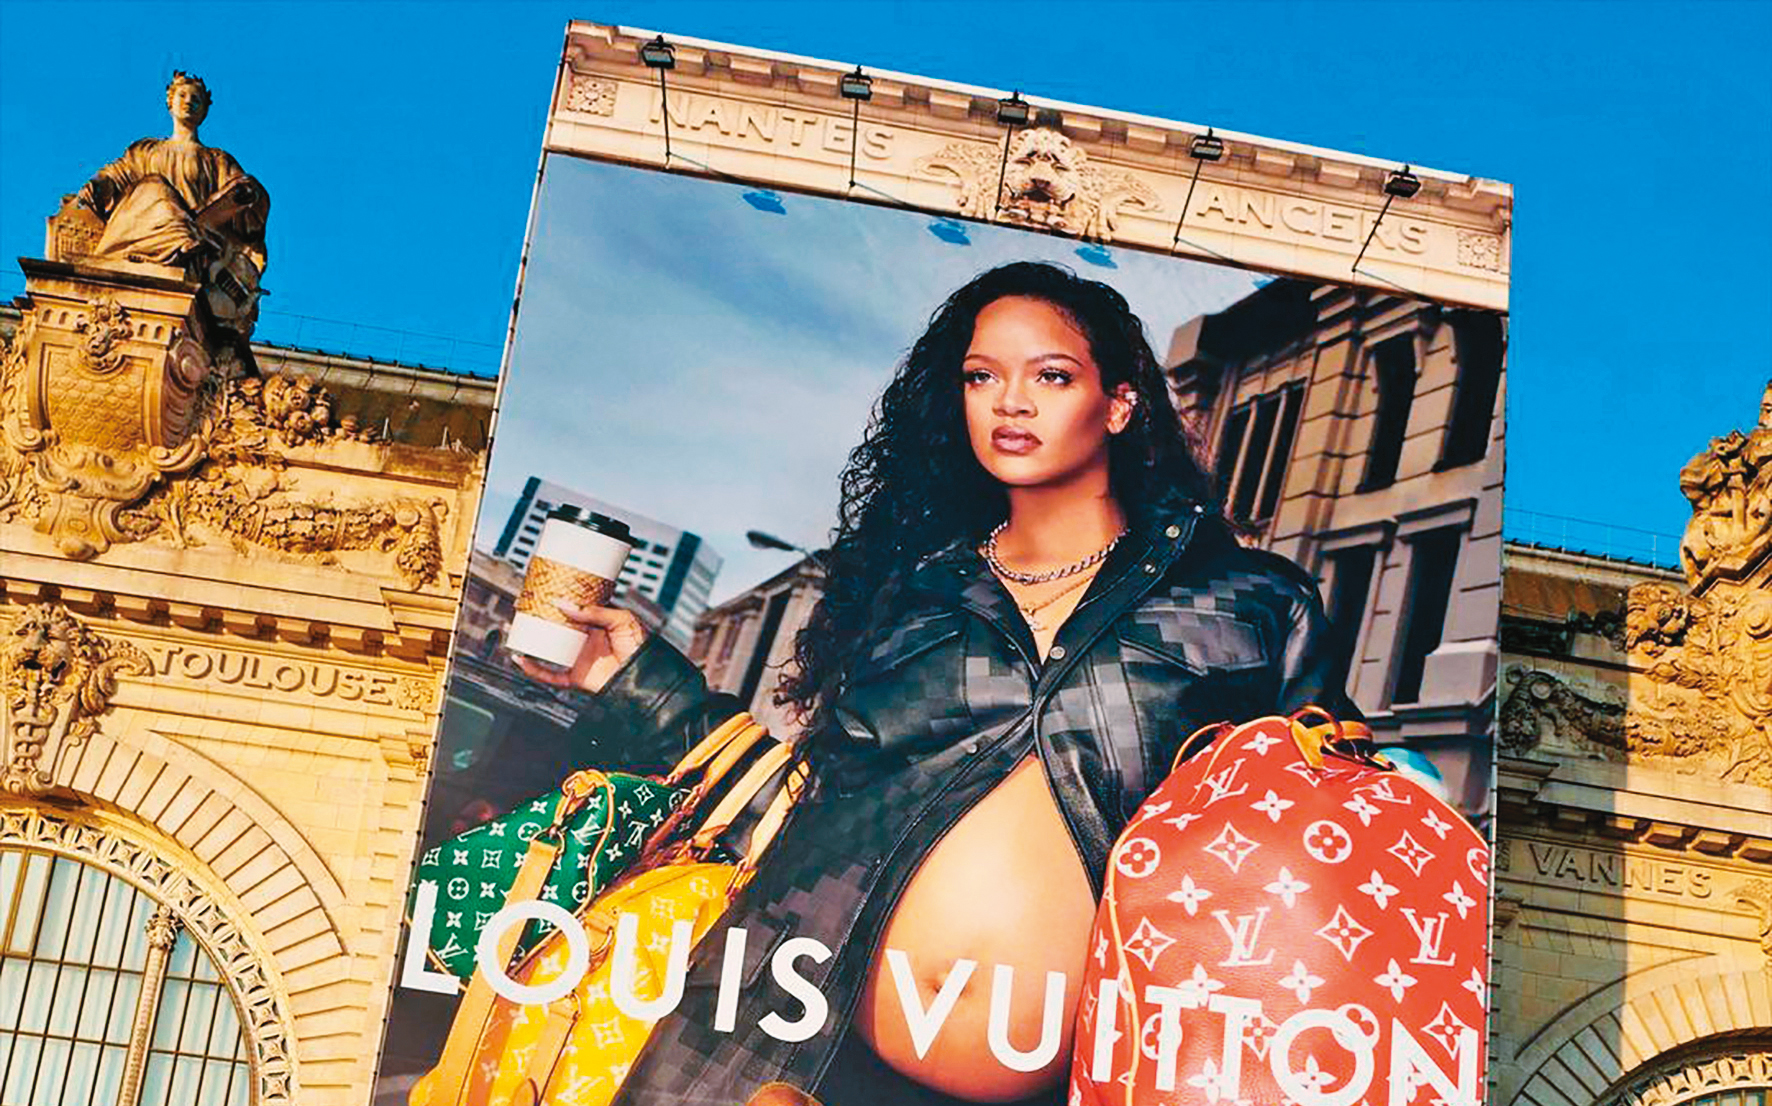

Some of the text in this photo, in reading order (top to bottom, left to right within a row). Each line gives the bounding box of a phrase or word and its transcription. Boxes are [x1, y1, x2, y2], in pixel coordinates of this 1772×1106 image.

[650, 90, 894, 159] NANTES
[153, 646, 397, 705] TOULOUSE
[1528, 843, 1712, 898] VANNES
[400, 882, 834, 1043] LOUIS
[1211, 906, 1277, 967] LV
[1399, 907, 1457, 967] LV
